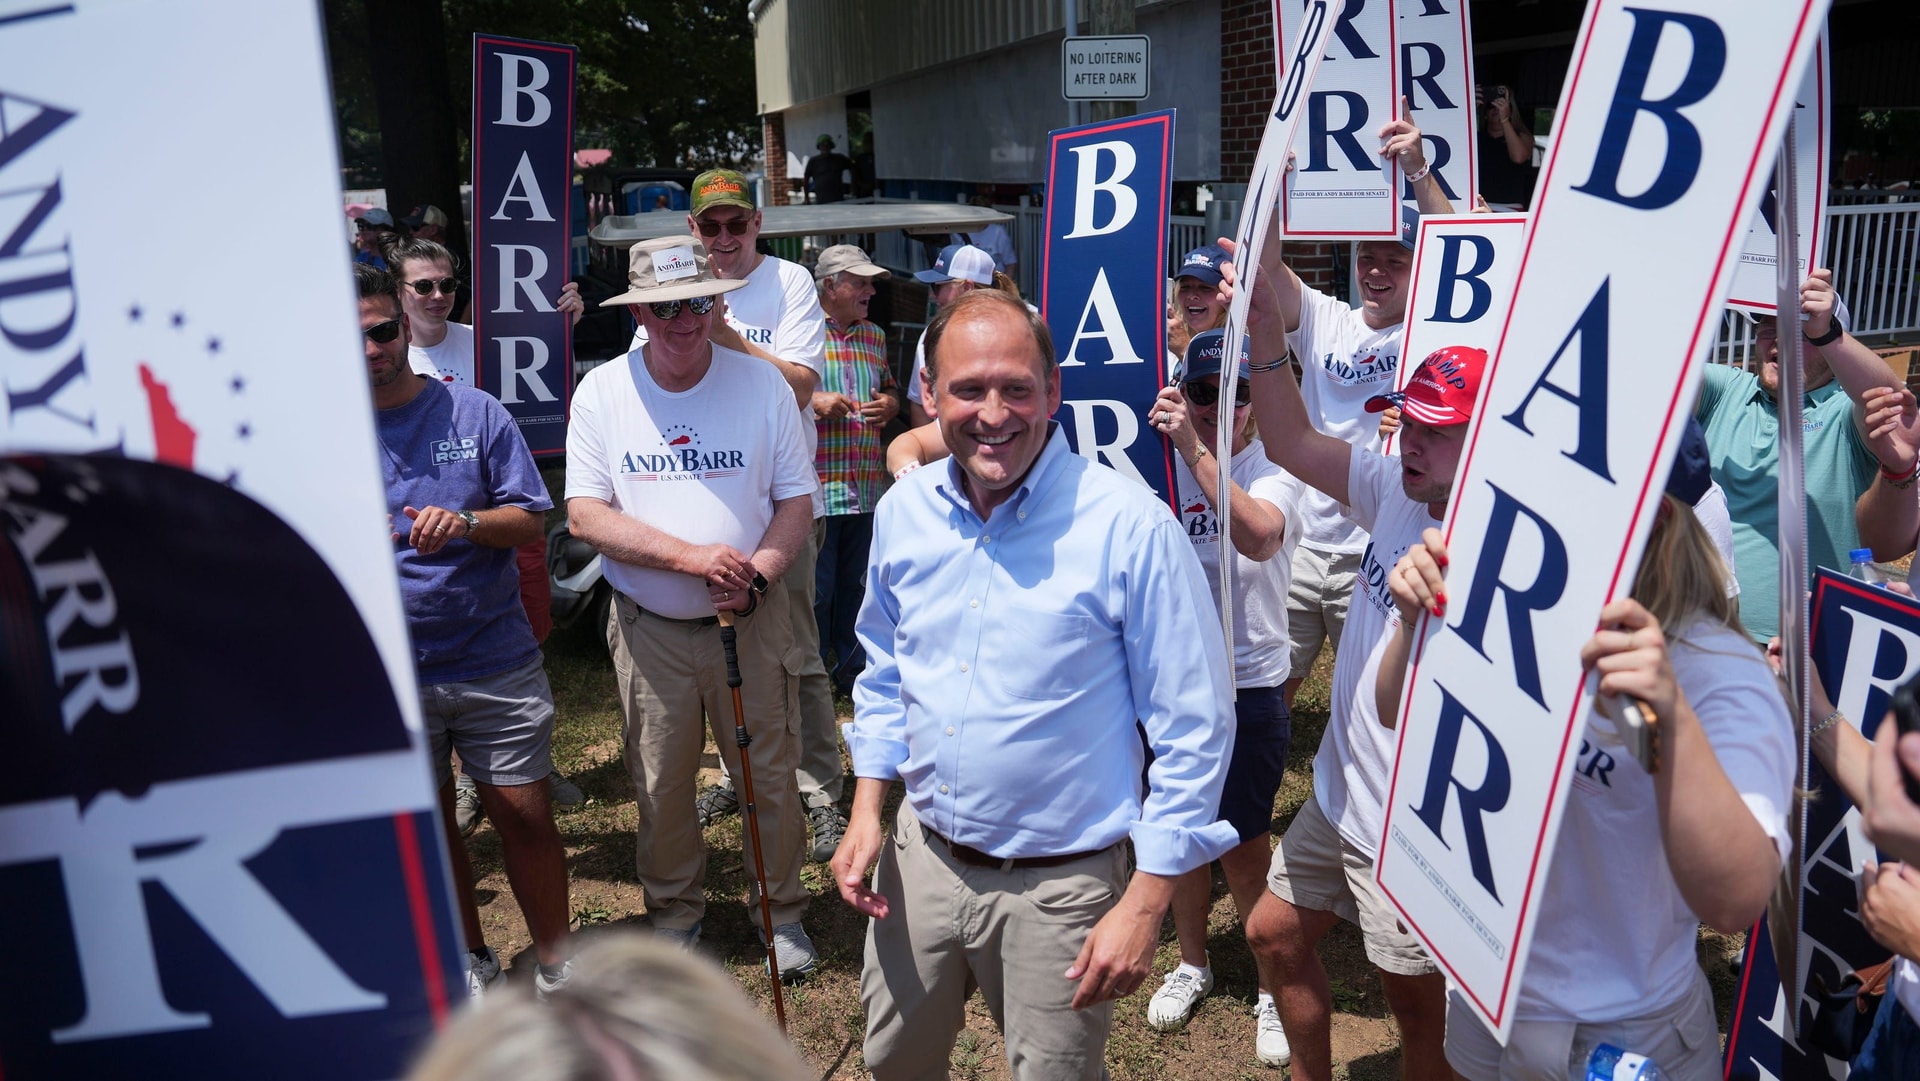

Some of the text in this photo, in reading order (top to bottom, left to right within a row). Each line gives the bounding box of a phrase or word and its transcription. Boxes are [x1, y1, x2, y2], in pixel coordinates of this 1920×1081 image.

[1070, 52, 1142, 65] NO LOITERING
[1074, 72, 1137, 85] AFTER DARK
[490, 52, 559, 404] BARR
[438, 438, 475, 451] OLD
[435, 448, 479, 462] ROW
[1409, 6, 1727, 906] BARR
[674, 473, 702, 481] SENATE
